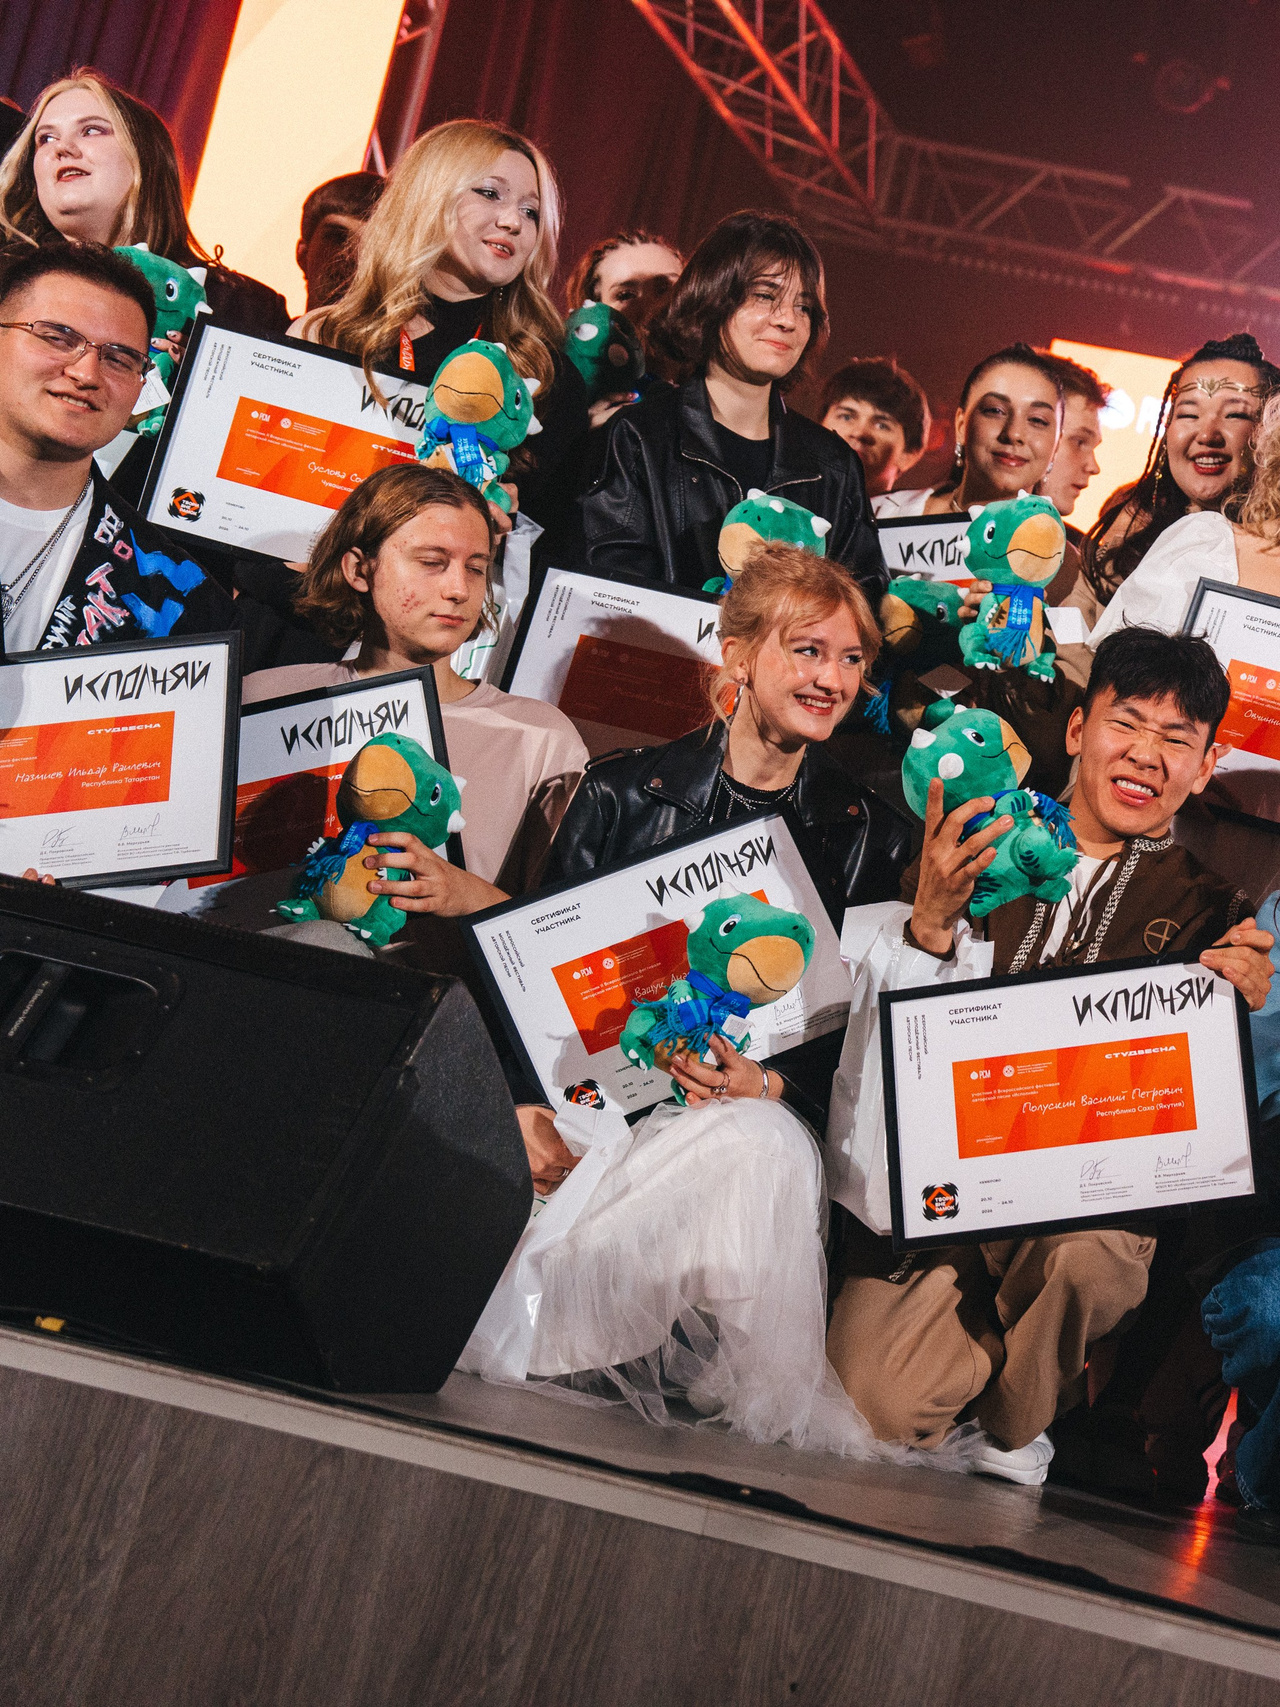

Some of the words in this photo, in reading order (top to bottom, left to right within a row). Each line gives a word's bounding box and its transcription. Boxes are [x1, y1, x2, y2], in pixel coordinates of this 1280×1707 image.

[250, 360, 294, 377] УЧАСТНИКА
[252, 351, 302, 370] СЕРТИФИКАТ
[308, 461, 346, 479] Суслова
[591, 600, 633, 615] УЧАСТНИКА
[593, 591, 640, 607] СЕРТИФИКАТ
[64, 660, 212, 705] ИСПОЛНЯЙ
[87, 722, 162, 735] СТУДВЕСНА
[280, 699, 409, 757] ИСПОЛНЯЙ
[68, 764, 107, 778] Ильдар
[112, 761, 162, 773] Раилевич
[81, 778, 122, 788] Республика
[124, 775, 161, 784] Татарстан
[645, 835, 779, 907] ИСПОЛНЯЙ
[530, 902, 581, 926] СЕРТИФИКАТ
[535, 914, 581, 935] УЧАСТНИКА
[948, 1003, 1002, 1016] СЕРТИФИКАТ
[1072, 976, 1215, 1027] ИСПОЛНЯЙ
[949, 1014, 998, 1026] УЧАСТНИКА
[1104, 1045, 1177, 1059] СТУДВЕСНА
[1022, 1100, 1076, 1115] Полускин
[1081, 1090, 1126, 1107] Василий
[1131, 1087, 1184, 1102] Петрович
[1096, 1108, 1136, 1118] Республика
[1137, 1104, 1155, 1113] Саха
[1156, 1101, 1185, 1111] (Якутия)
